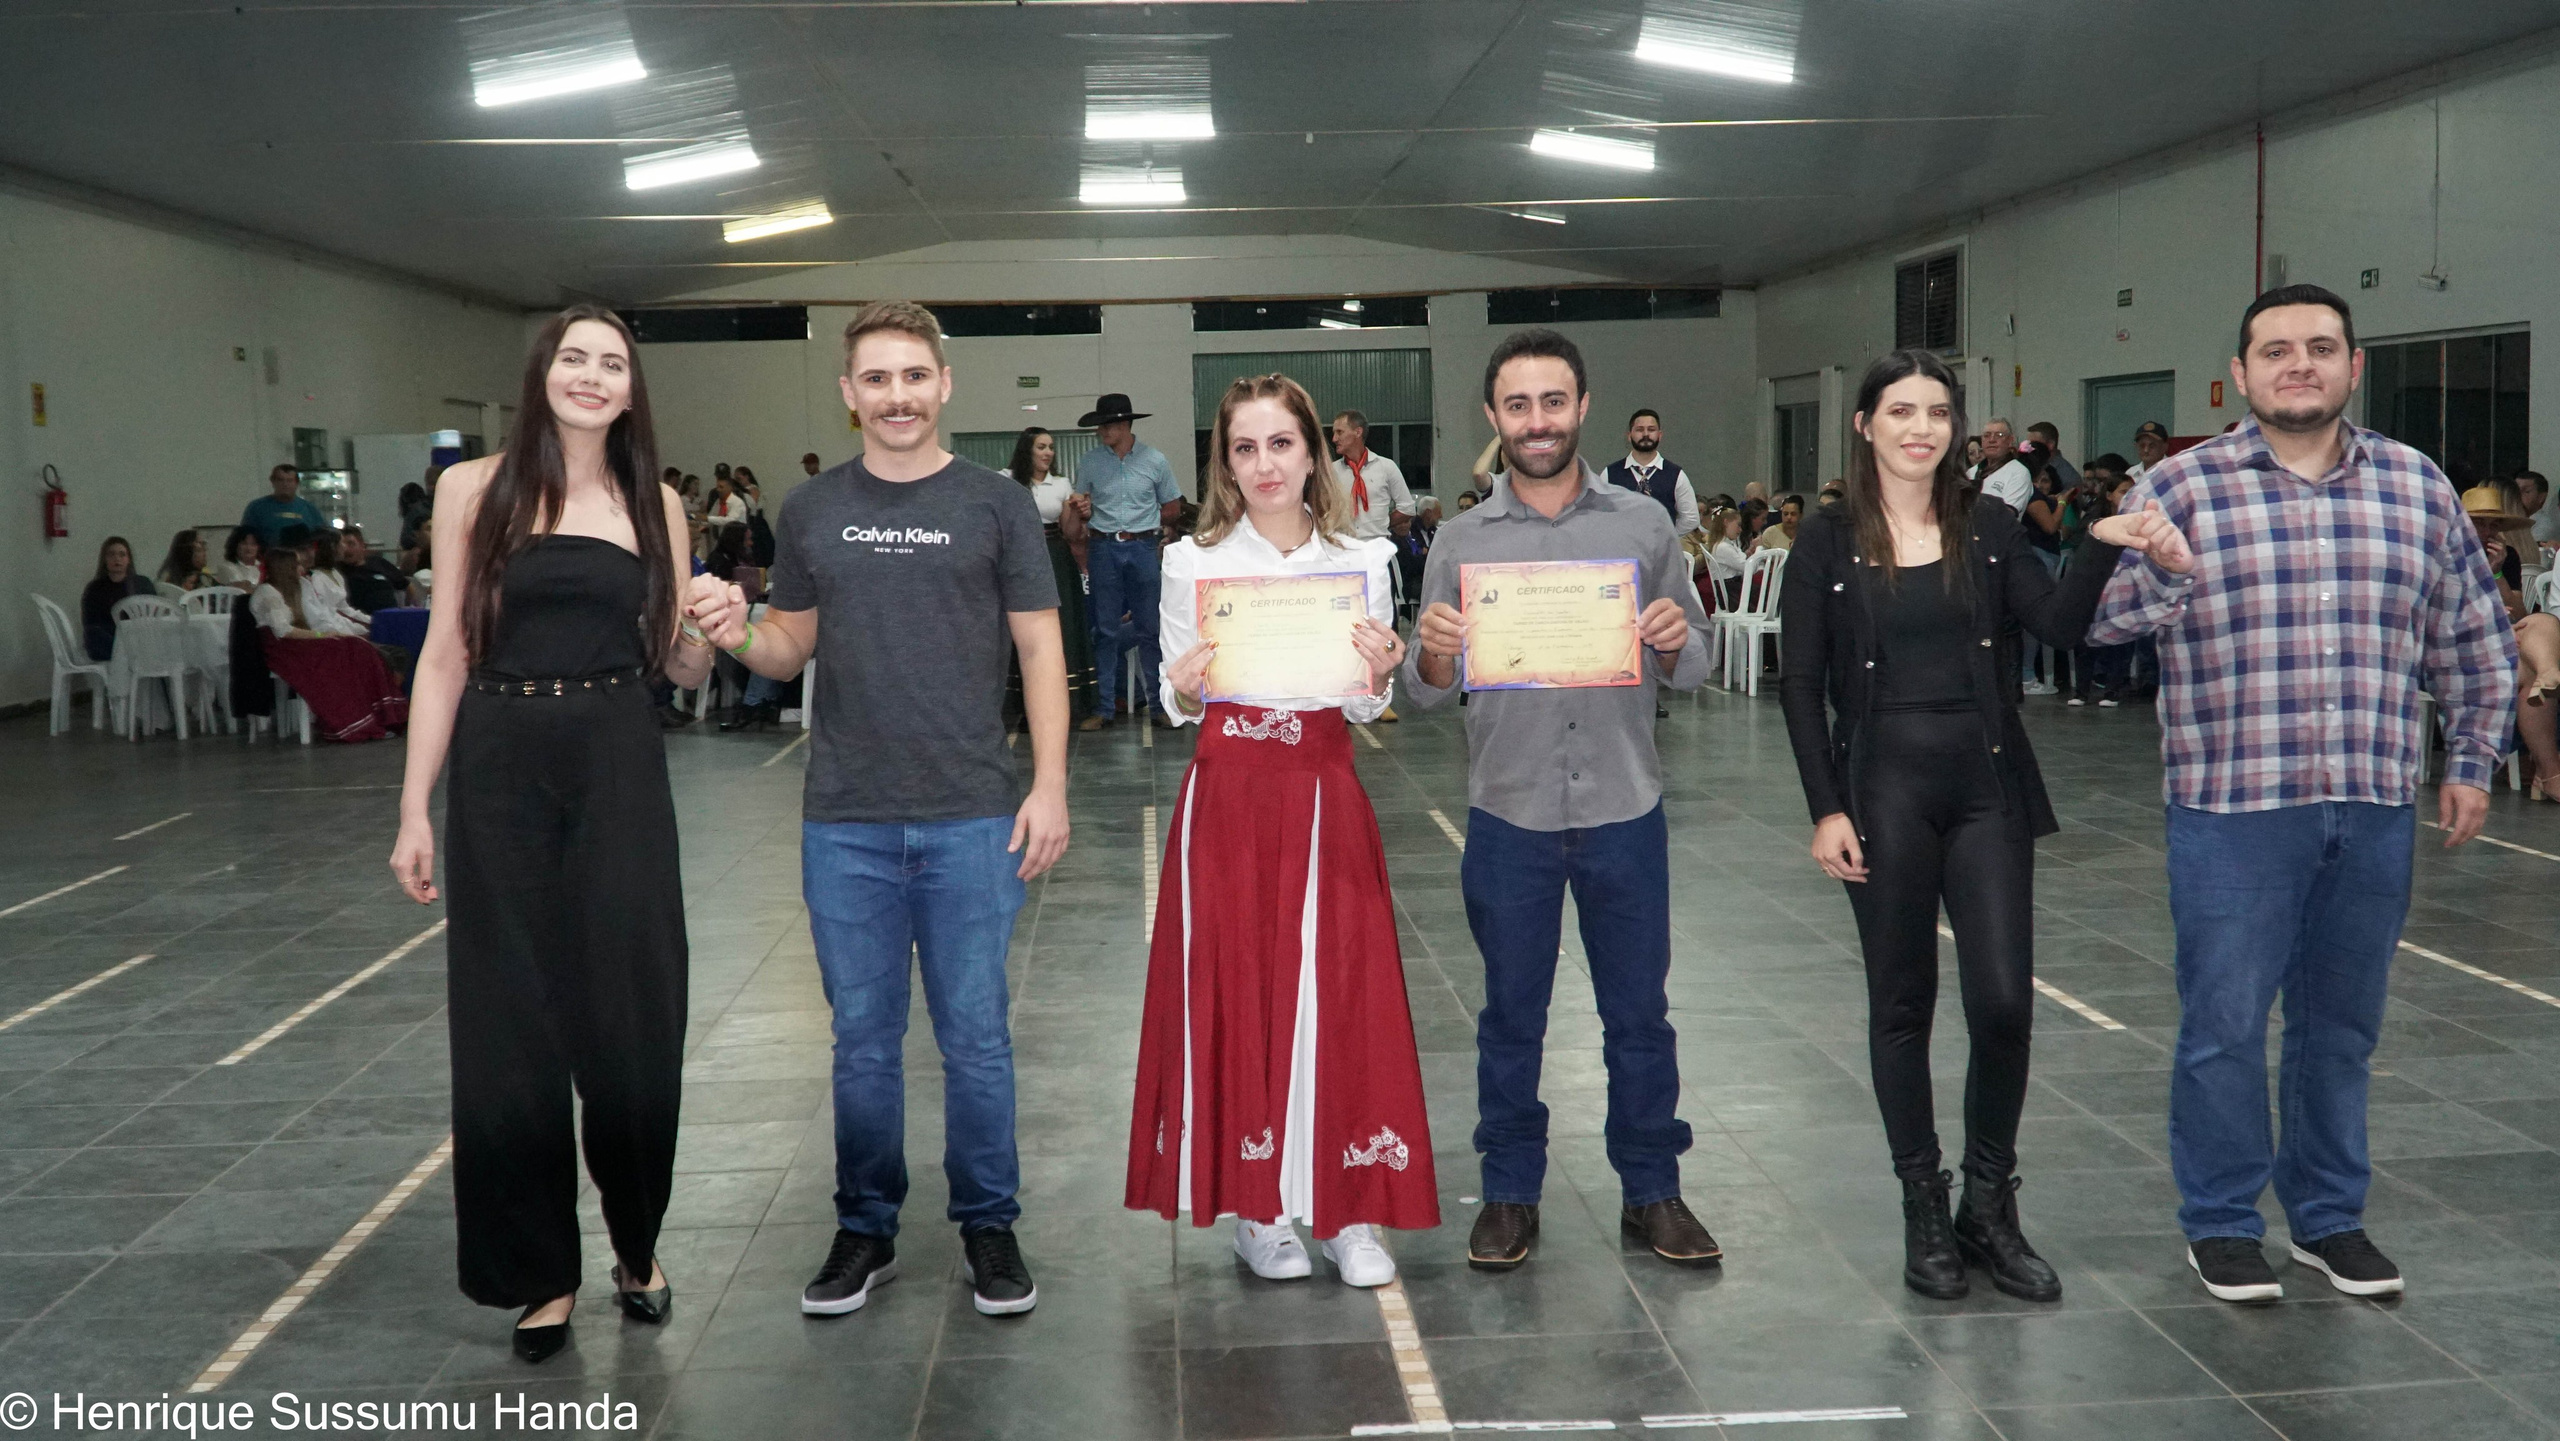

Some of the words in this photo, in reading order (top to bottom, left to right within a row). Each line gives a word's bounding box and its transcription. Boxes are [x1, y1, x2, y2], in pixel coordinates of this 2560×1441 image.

[842, 526, 902, 542] Calvin
[905, 528, 950, 544] Klein
[1516, 585, 1585, 596] CERTIFICADO
[1250, 597, 1317, 608] CERTIFICADO
